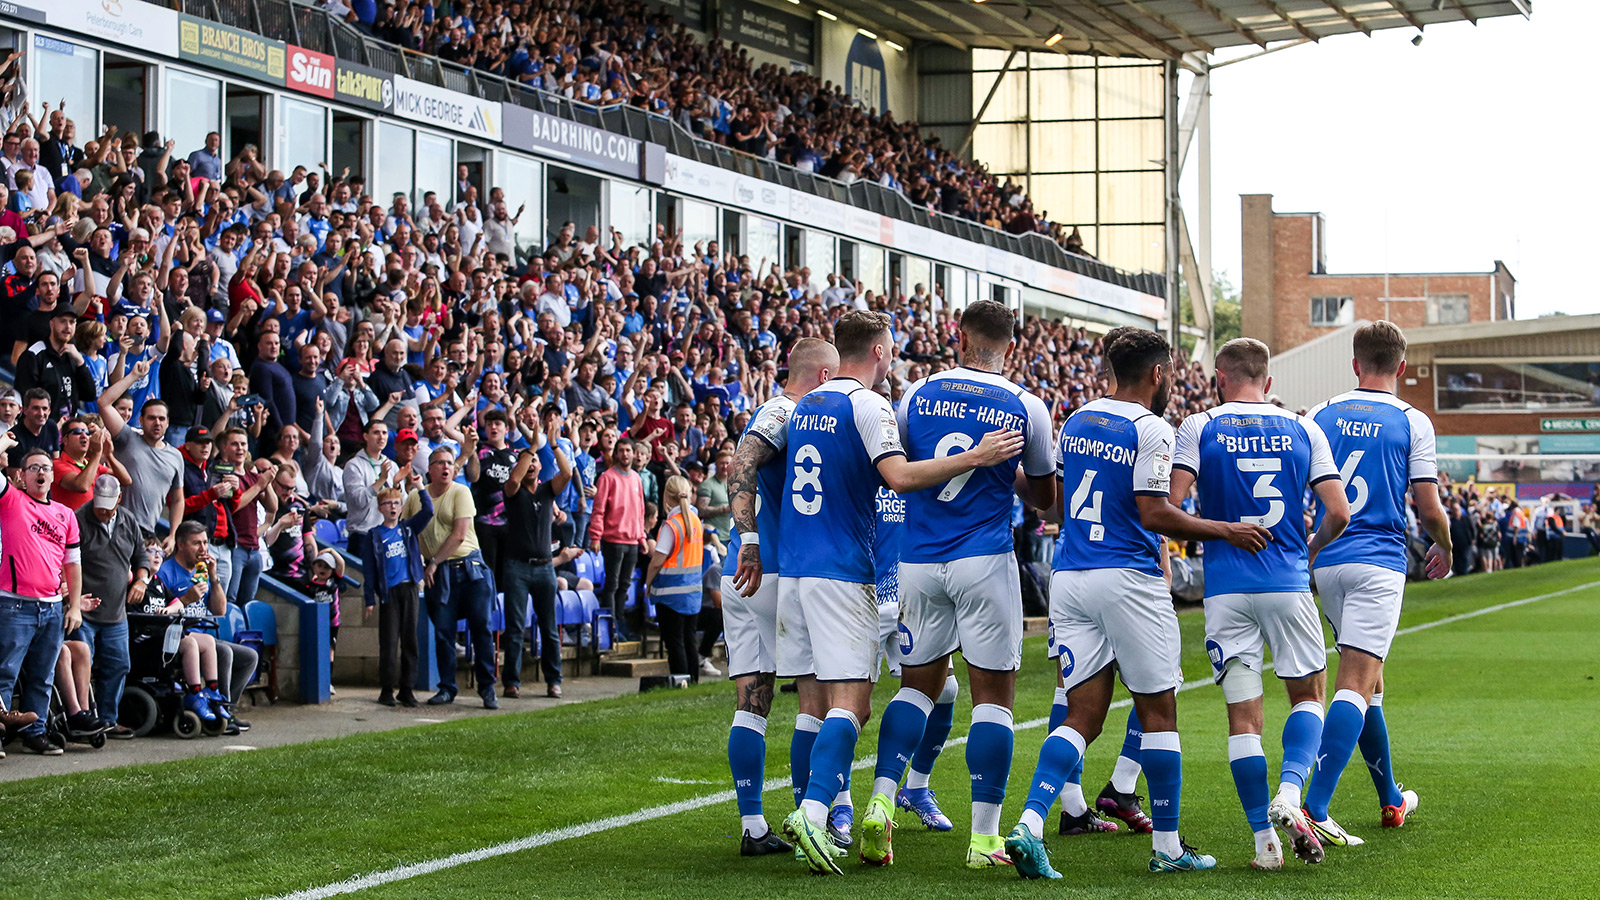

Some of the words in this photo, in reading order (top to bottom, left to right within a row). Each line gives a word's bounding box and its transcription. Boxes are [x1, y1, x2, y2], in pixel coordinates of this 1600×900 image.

[87, 11, 128, 36] Peterborough
[129, 23, 143, 38] Care
[201, 25, 241, 54] BRANCH
[241, 36, 266, 61] BROS
[290, 52, 332, 90] Sun
[337, 68, 382, 103] talkSPORT
[396, 90, 422, 115] MICK
[424, 97, 464, 125] GEORGE
[533, 113, 638, 165] BADRHINO.COM
[951, 382, 1010, 400] PRINCEBUILD
[795, 414, 838, 434] TAYLOR
[917, 399, 1025, 433] CLARKE-HARRIS
[1341, 420, 1383, 438] KENT
[1552, 420, 1582, 429] MEDICAL
[1063, 435, 1136, 467] THOMPSON
[1226, 435, 1293, 453] BUTLER
[792, 444, 823, 516] 8
[934, 432, 976, 502] 9
[1340, 450, 1369, 516] 6
[875, 499, 906, 514] ORGE
[1070, 468, 1105, 541] 4
[1236, 458, 1285, 529] 3
[736, 778, 752, 788] PUFC
[1038, 780, 1056, 795] PUFC
[1153, 799, 1169, 807] PUFC
